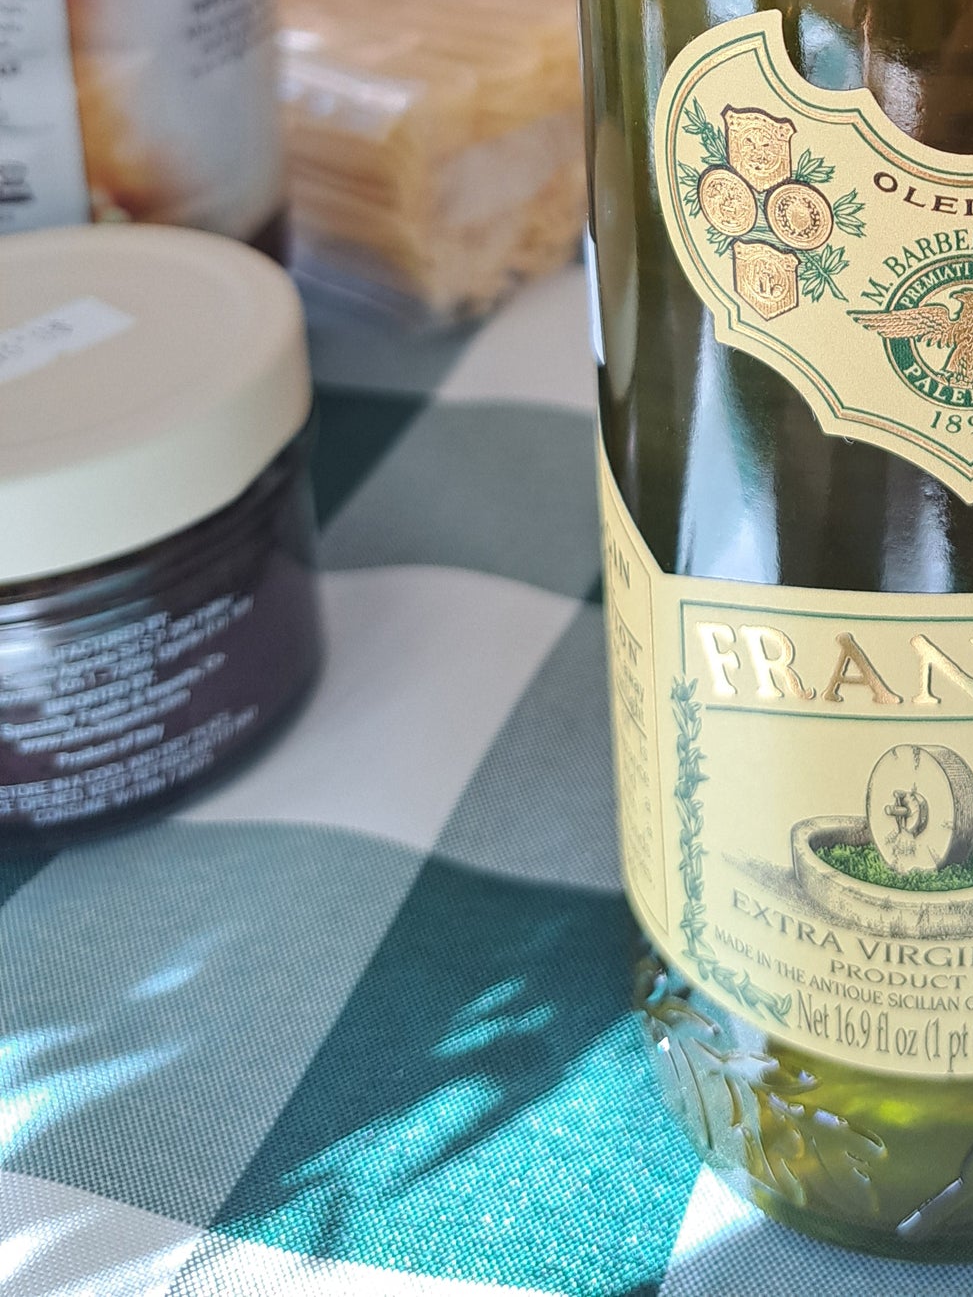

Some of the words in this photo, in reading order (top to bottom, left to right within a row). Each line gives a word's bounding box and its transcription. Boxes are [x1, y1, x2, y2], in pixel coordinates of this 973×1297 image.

[861, 277, 894, 306] M.
[900, 262, 970, 308] PREMIATI
[732, 888, 845, 954] EXTRA
[714, 925, 755, 958] MADE
[757, 950, 771, 968] IN
[775, 961, 806, 983] THE
[809, 974, 883, 1005] ANTIQUE
[888, 992, 960, 1011] SICILIAN
[830, 959, 967, 989] PRODUCT
[797, 989, 830, 1040] Net
[835, 1003, 871, 1049] 16.9
[876, 1011, 890, 1054] fl
[895, 1027, 918, 1056] oz
[924, 1017, 941, 1062] (1
[948, 1022, 968, 1073] pt
